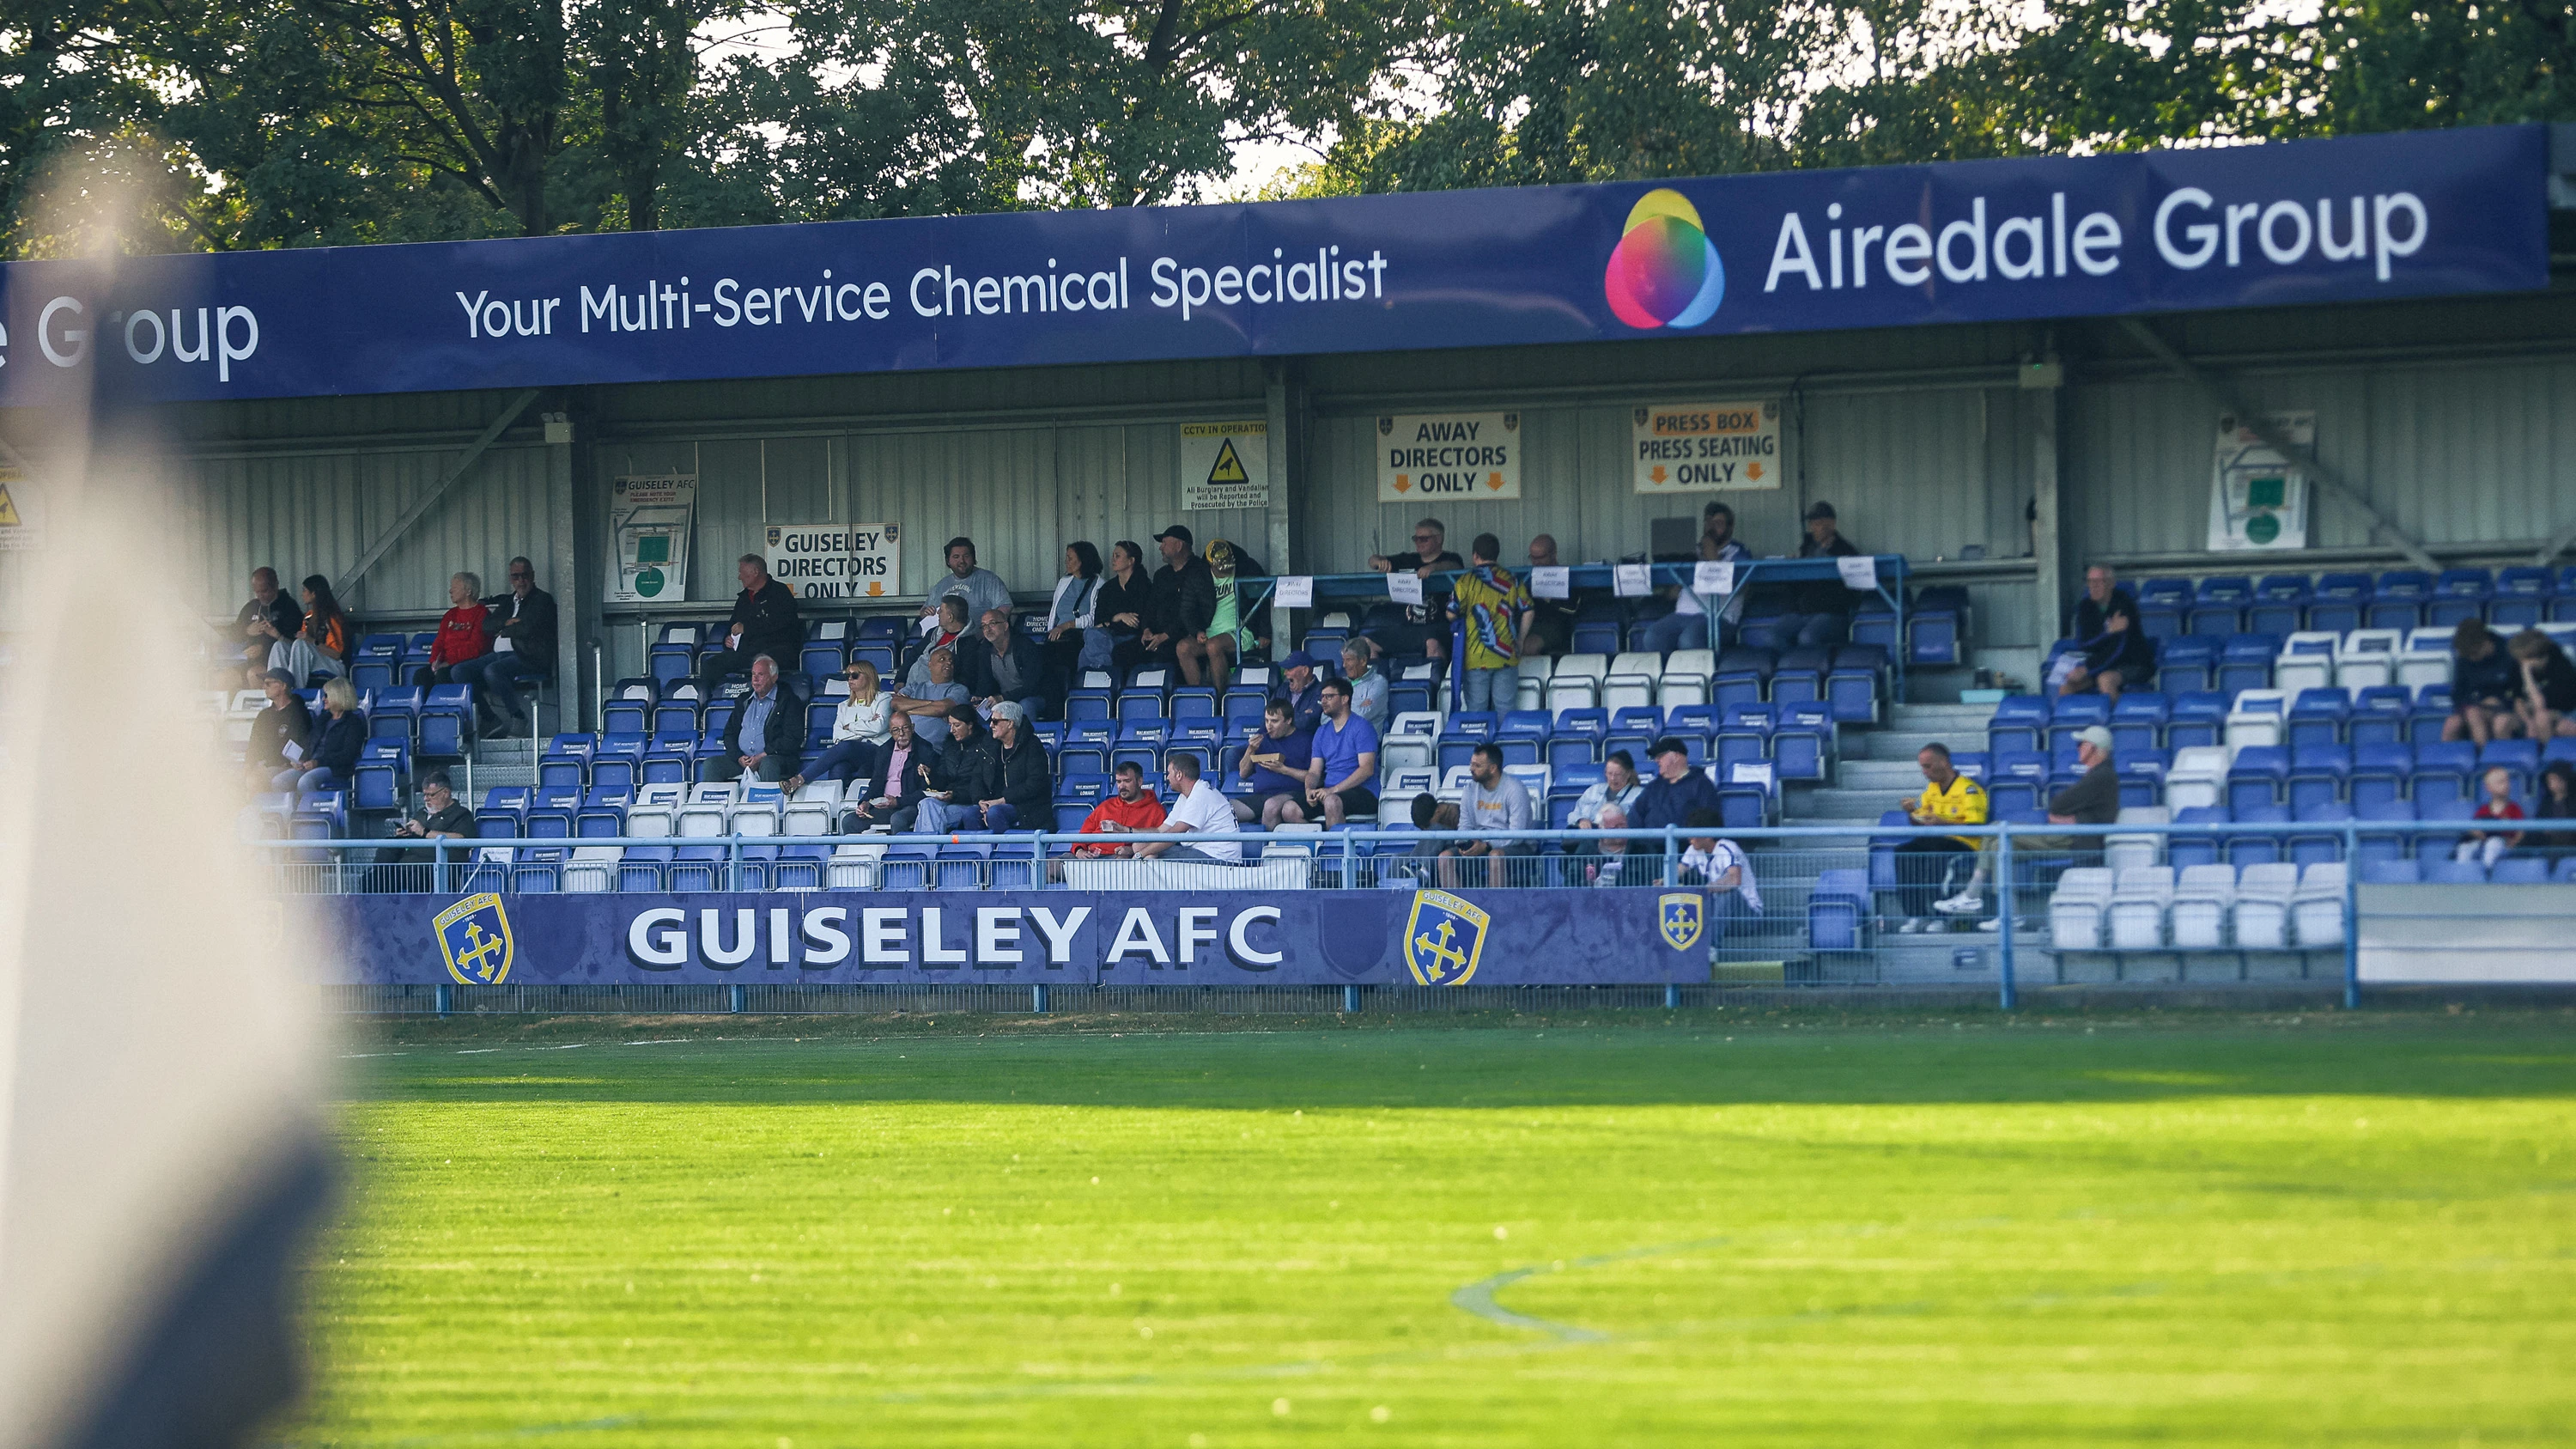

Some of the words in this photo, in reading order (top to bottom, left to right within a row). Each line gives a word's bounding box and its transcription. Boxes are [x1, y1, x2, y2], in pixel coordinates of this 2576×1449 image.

[1765, 192, 2122, 292] Airedale
[2155, 187, 2427, 281] Group
[456, 290, 561, 338] Your
[580, 270, 890, 335] Multi-Service
[910, 256, 1128, 317] Chemical
[1151, 245, 1388, 321] Specialist
[39, 295, 258, 382] Goup
[1183, 426, 1206, 435] CCTV
[1208, 425, 1218, 434] IN
[1416, 421, 1480, 442] AWAY
[1656, 413, 1711, 432] PRESS
[1717, 411, 1754, 429] BOX
[1390, 446, 1507, 468] DIRECTORS
[1639, 438, 1692, 460] PRESS
[1698, 435, 1774, 458] SEATING
[1419, 472, 1477, 492] ONLY
[1677, 462, 1735, 484] ONLY
[629, 480, 674, 490] GUISELEY
[676, 479, 695, 490] AFC
[1219, 492, 1248, 502] Reported
[1227, 500, 1235, 508] by
[785, 533, 880, 553] GUISELEY
[777, 557, 887, 577] DIRECTORS
[805, 581, 859, 598] ONLY
[439, 899, 477, 925] GUISELEY
[477, 894, 493, 905] AFC
[1423, 892, 1465, 910] GUISELEY
[1466, 908, 1482, 922] AFC
[629, 906, 1092, 965] GUISELEY
[1107, 905, 1283, 965] AFC
